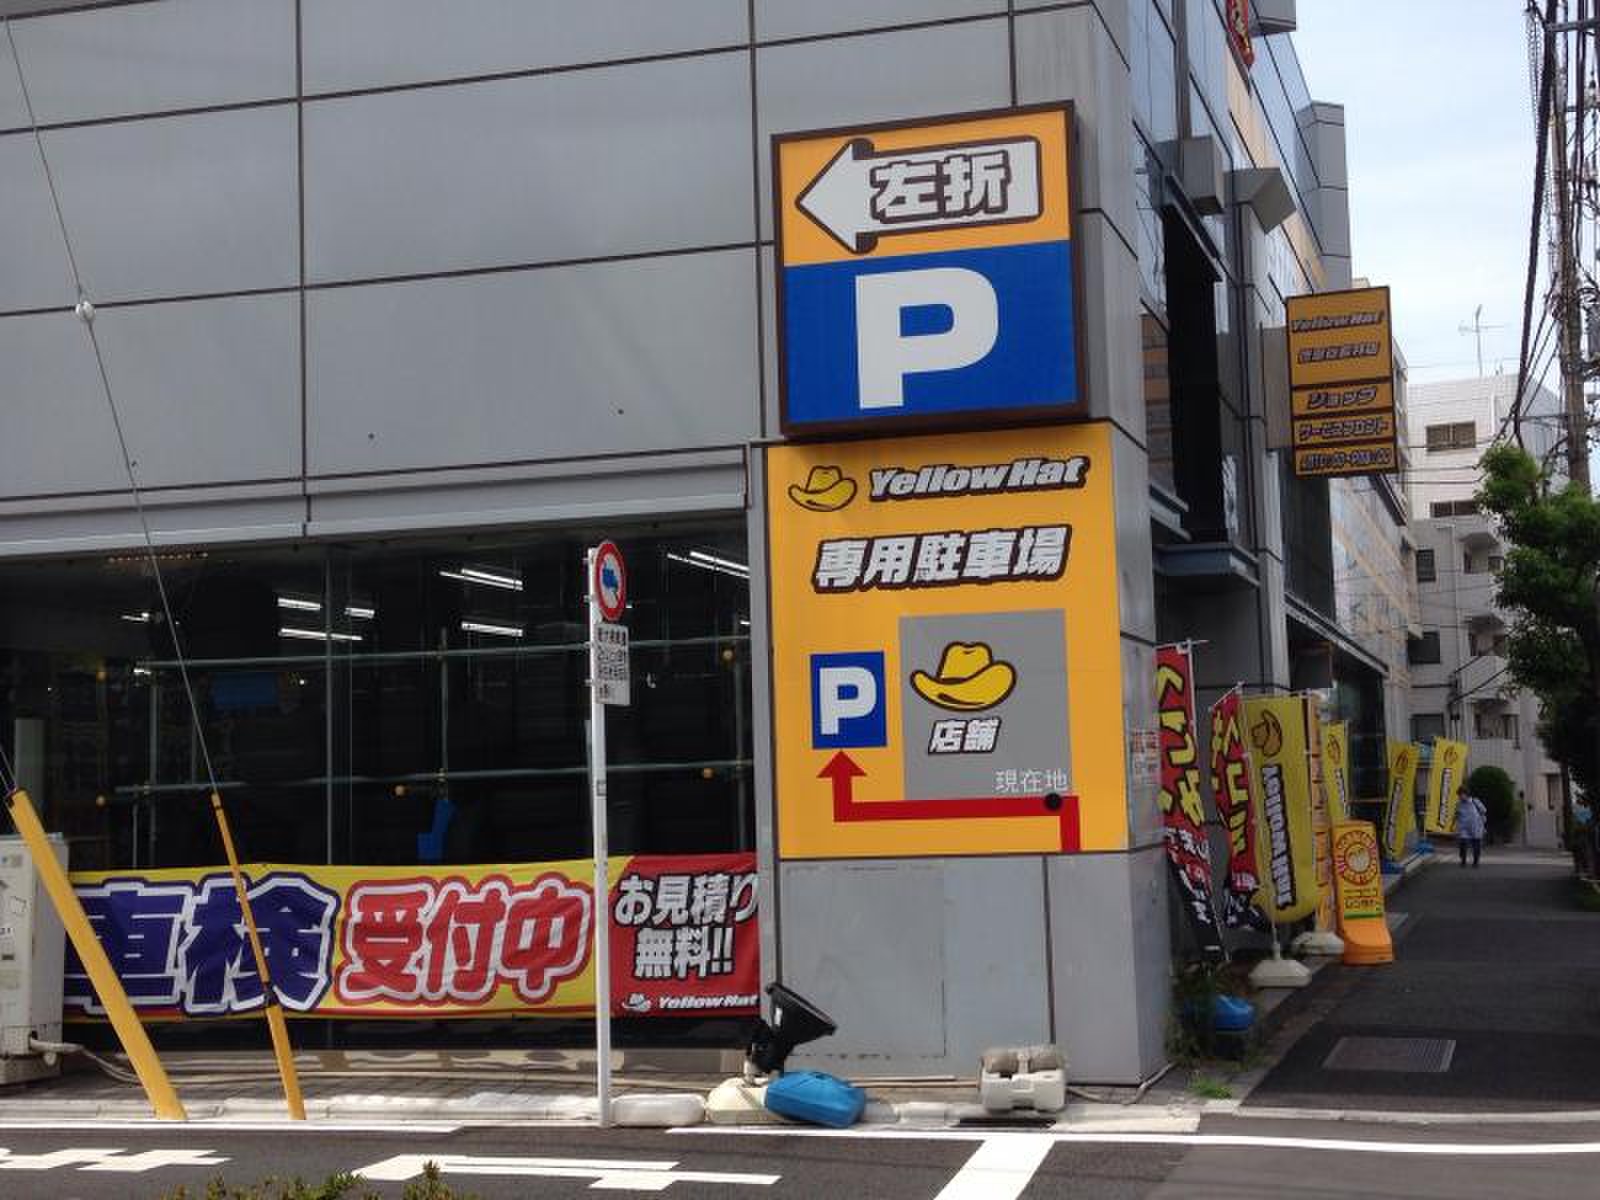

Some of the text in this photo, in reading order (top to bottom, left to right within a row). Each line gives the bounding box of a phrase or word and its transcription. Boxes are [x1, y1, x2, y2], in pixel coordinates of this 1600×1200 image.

[869, 149, 1011, 224] 左折
[855, 267, 998, 409] P
[813, 524, 1072, 594] 専用駐車場
[819, 666, 877, 735] P
[928, 716, 1000, 755] 店舗
[995, 768, 1069, 794] 現在地
[614, 873, 759, 926] お見積り
